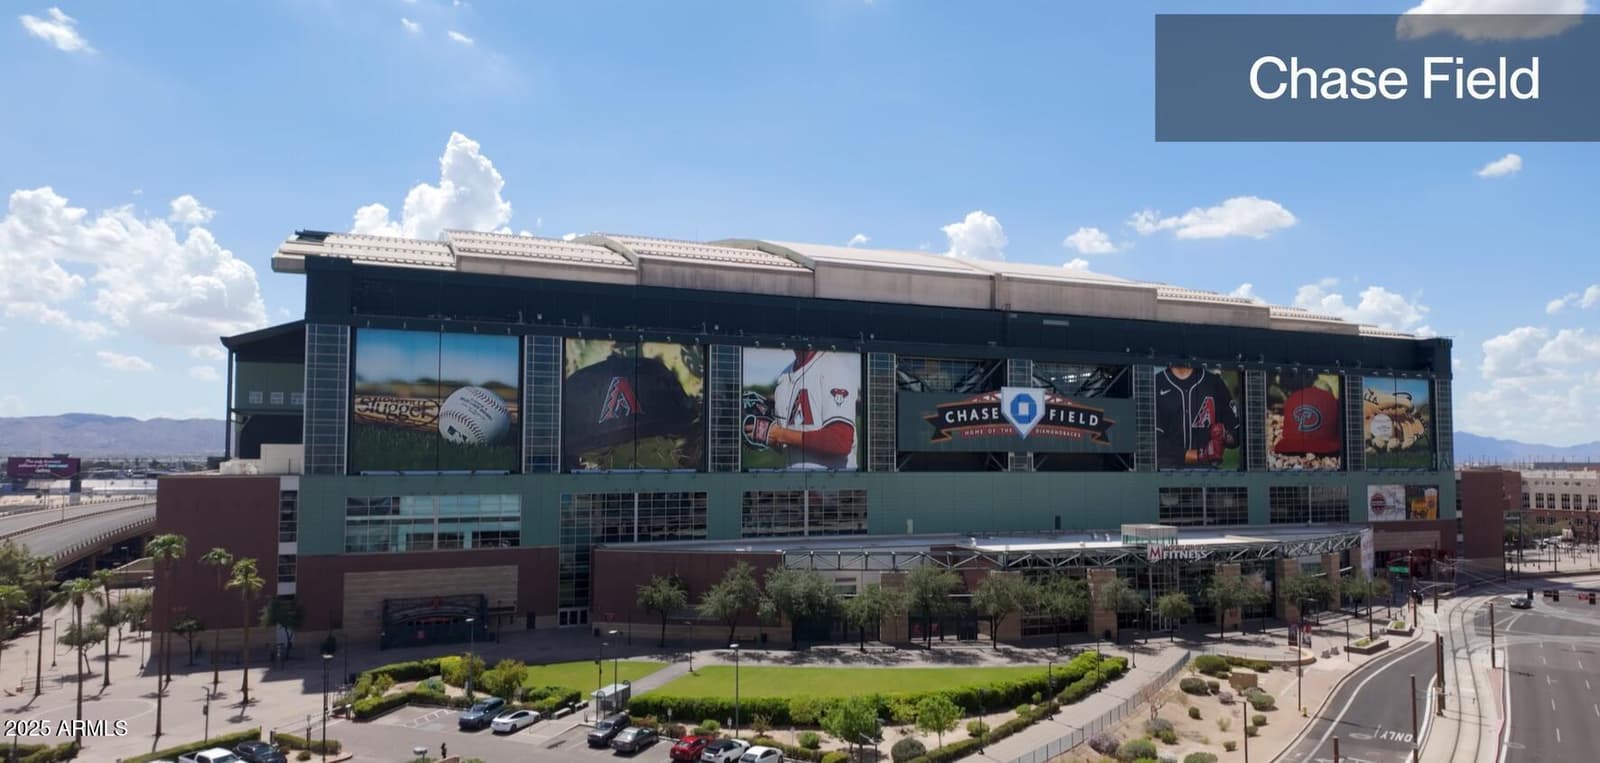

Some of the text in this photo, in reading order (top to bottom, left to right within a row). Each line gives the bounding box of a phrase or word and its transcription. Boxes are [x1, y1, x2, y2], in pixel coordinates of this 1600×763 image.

[944, 407, 1099, 427] CHASE FIELD
[963, 428, 984, 436] HOME
[1034, 428, 1082, 438] DIAMONDBACKS
[1380, 730, 1413, 742] ONLY
